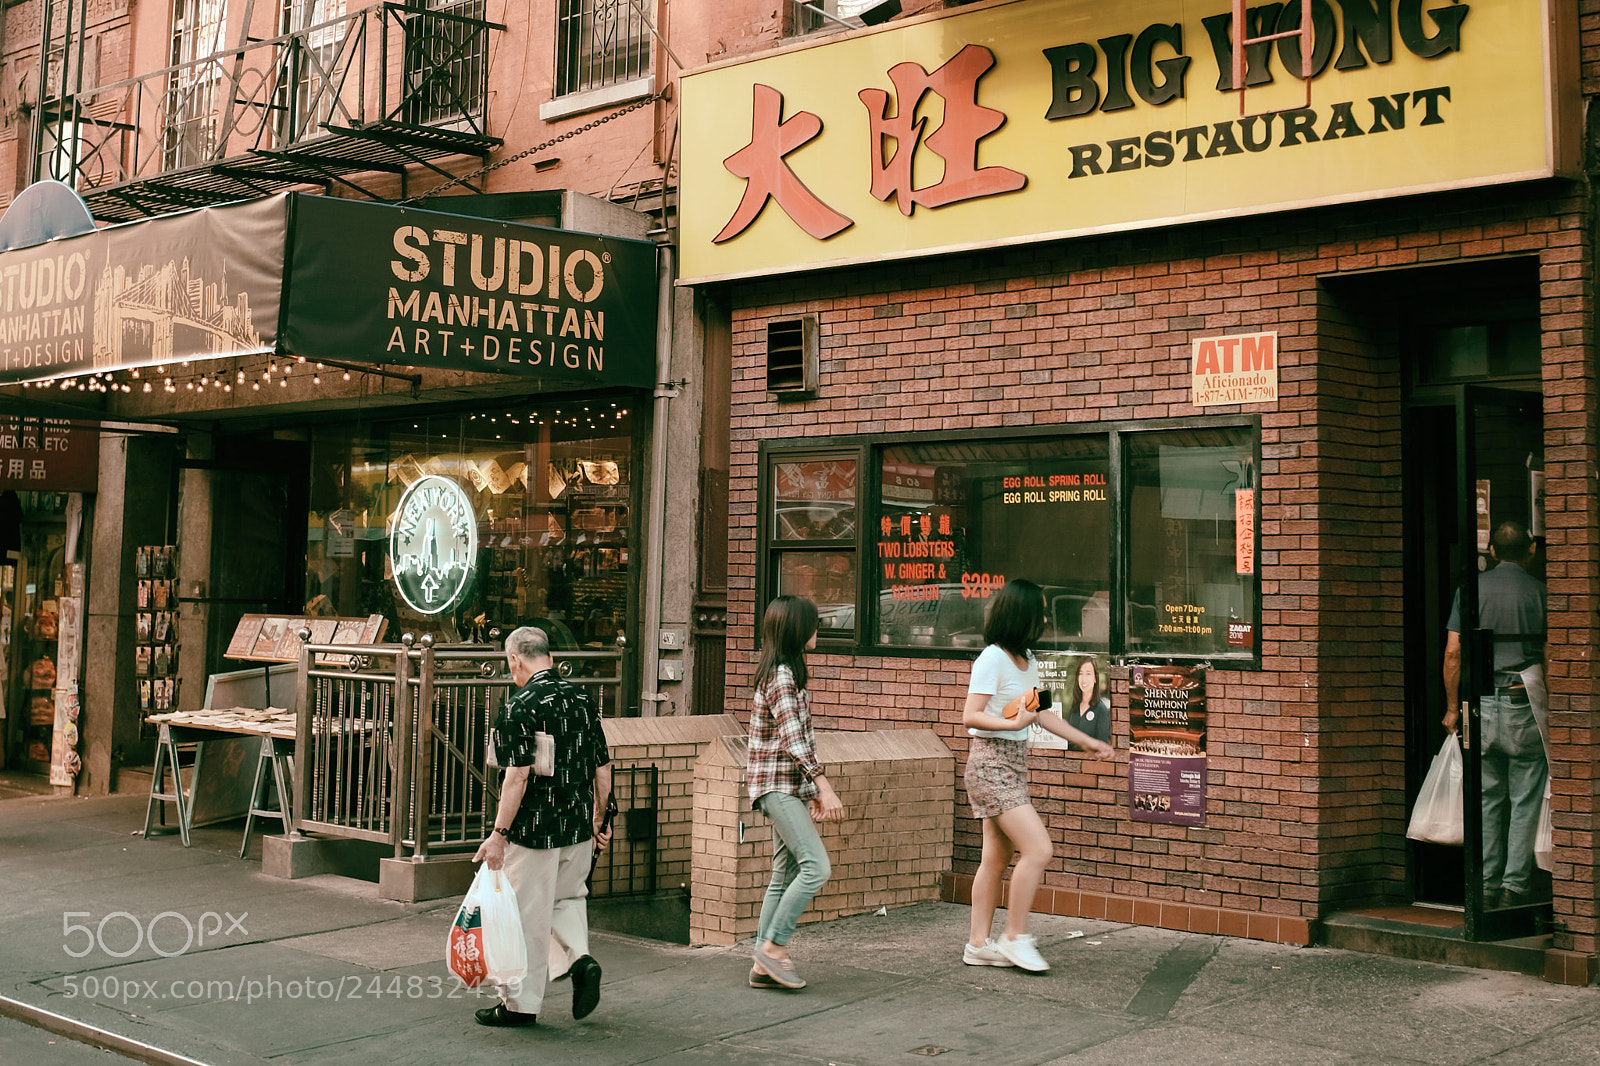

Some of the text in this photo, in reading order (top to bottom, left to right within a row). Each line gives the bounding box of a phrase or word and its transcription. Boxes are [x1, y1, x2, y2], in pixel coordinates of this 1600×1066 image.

[1043, 0, 1470, 121] BIG WONG
[1067, 86, 1452, 179] RESTAURANT
[713, 43, 1028, 244] 大旺
[390, 225, 605, 304] STUDIO
[0, 252, 86, 313] TUDIO
[387, 287, 605, 341] MANHATTAN
[1196, 335, 1274, 375] ATM
[1203, 373, 1267, 389] Aficionado
[1196, 386, 1275, 403] 1-877-ATM-7790
[45, 437, 69, 452] ETC
[0, 459, 46, 479] 用品
[1003, 473, 1106, 489] EGG ROLL SPRING ROLL
[1003, 489, 1106, 504] EGG ROLL SPRING ROLL
[877, 540, 955, 558] TWO LOBSTERS
[884, 563, 946, 579] W. GINGER &
[891, 584, 940, 601] SCALLION
[1165, 604, 1206, 615] Open 7 Days
[1158, 625, 1173, 634] 7:00
[1201, 627, 1212, 635] pm
[1229, 624, 1252, 633] ZAGAT
[1144, 689, 1189, 699] SHEN YUN
[1144, 699, 1189, 709] SYMPHONY
[1144, 709, 1188, 720] ORCHESTRA
